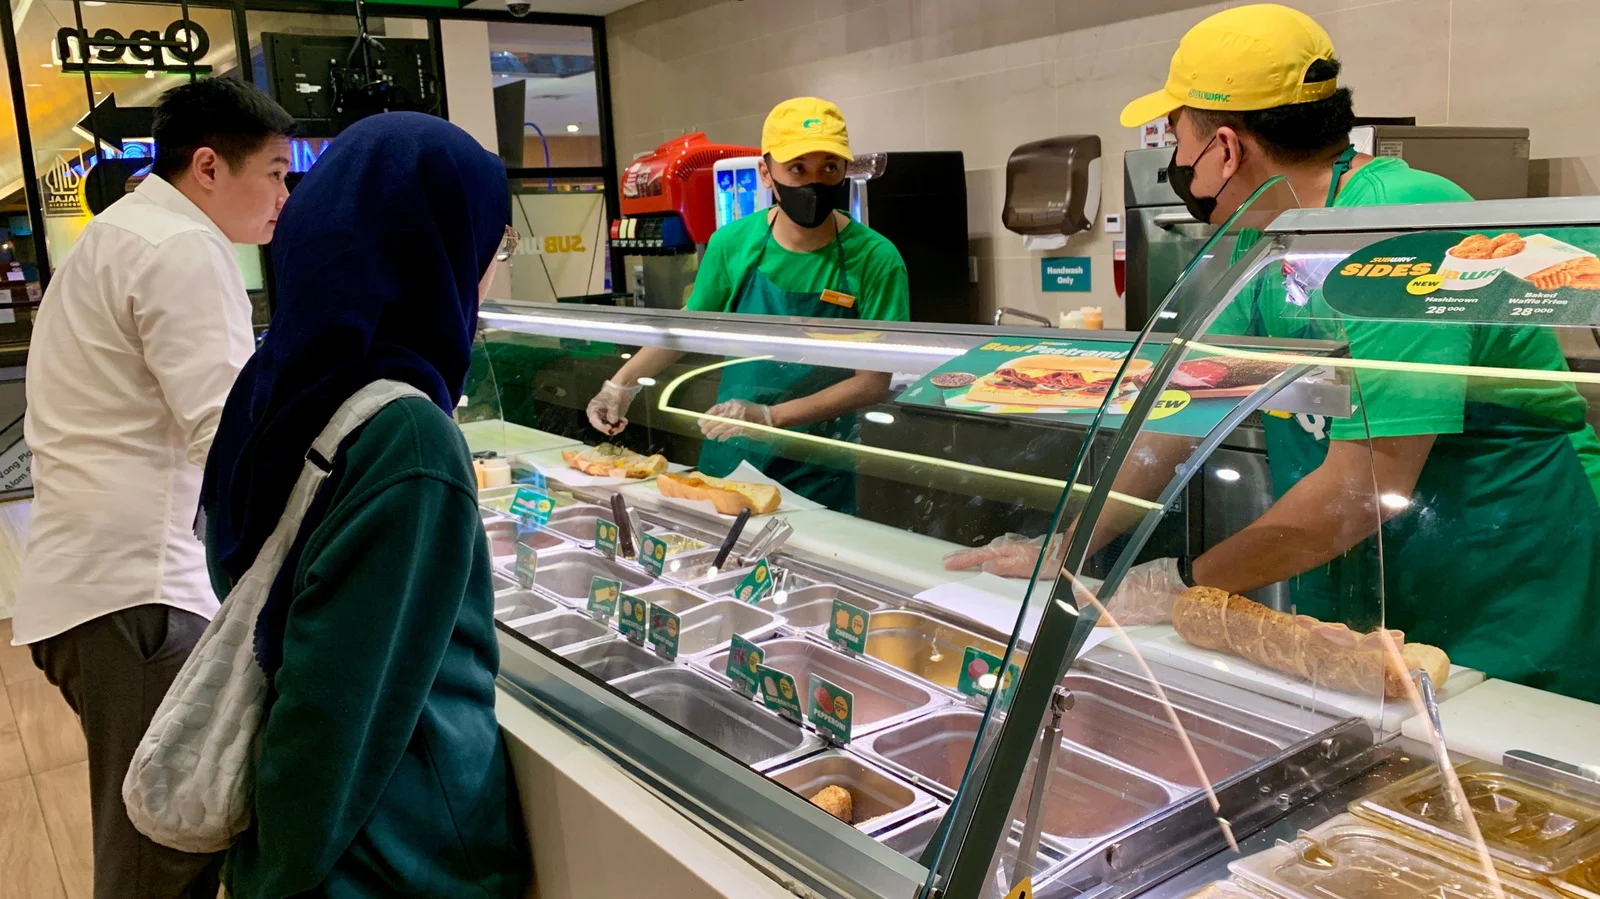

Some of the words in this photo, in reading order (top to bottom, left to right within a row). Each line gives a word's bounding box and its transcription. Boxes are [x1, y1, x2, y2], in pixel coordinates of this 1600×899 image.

[1046, 265, 1084, 275] Handwash
[1340, 262, 1433, 277] SIDES
[1056, 276, 1075, 286] Only
[1425, 306, 1446, 314] 28
[1510, 308, 1534, 316] 28
[980, 342, 1029, 352] Beef
[1027, 344, 1129, 358] Pastrami
[1153, 399, 1187, 409] EW
[834, 629, 860, 644] CHEDDAR
[813, 708, 846, 731] PEPPERONI
